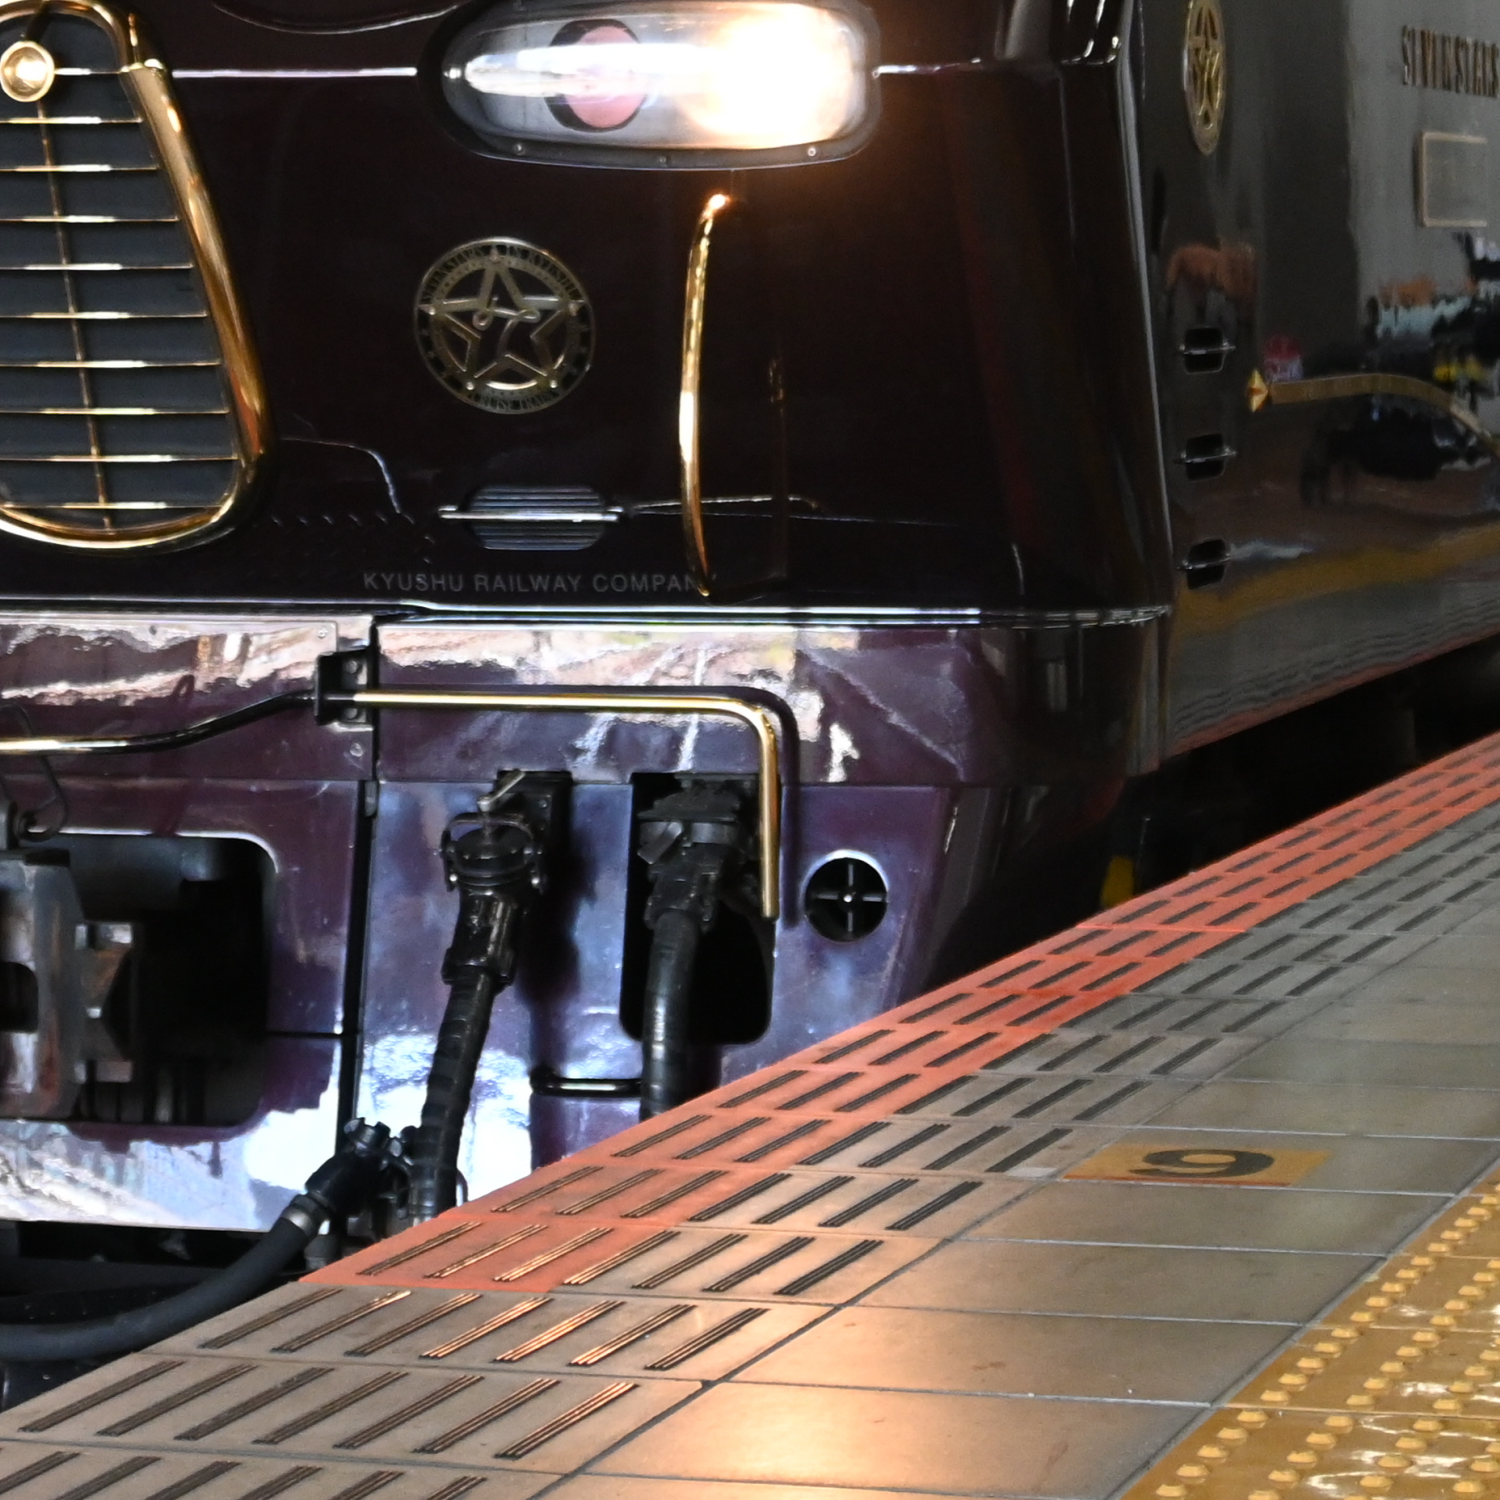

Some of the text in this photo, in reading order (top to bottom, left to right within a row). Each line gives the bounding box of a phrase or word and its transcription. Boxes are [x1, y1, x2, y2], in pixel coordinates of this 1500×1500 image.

[363, 572, 717, 593] KYUSHU RAILWAY COMPAN
